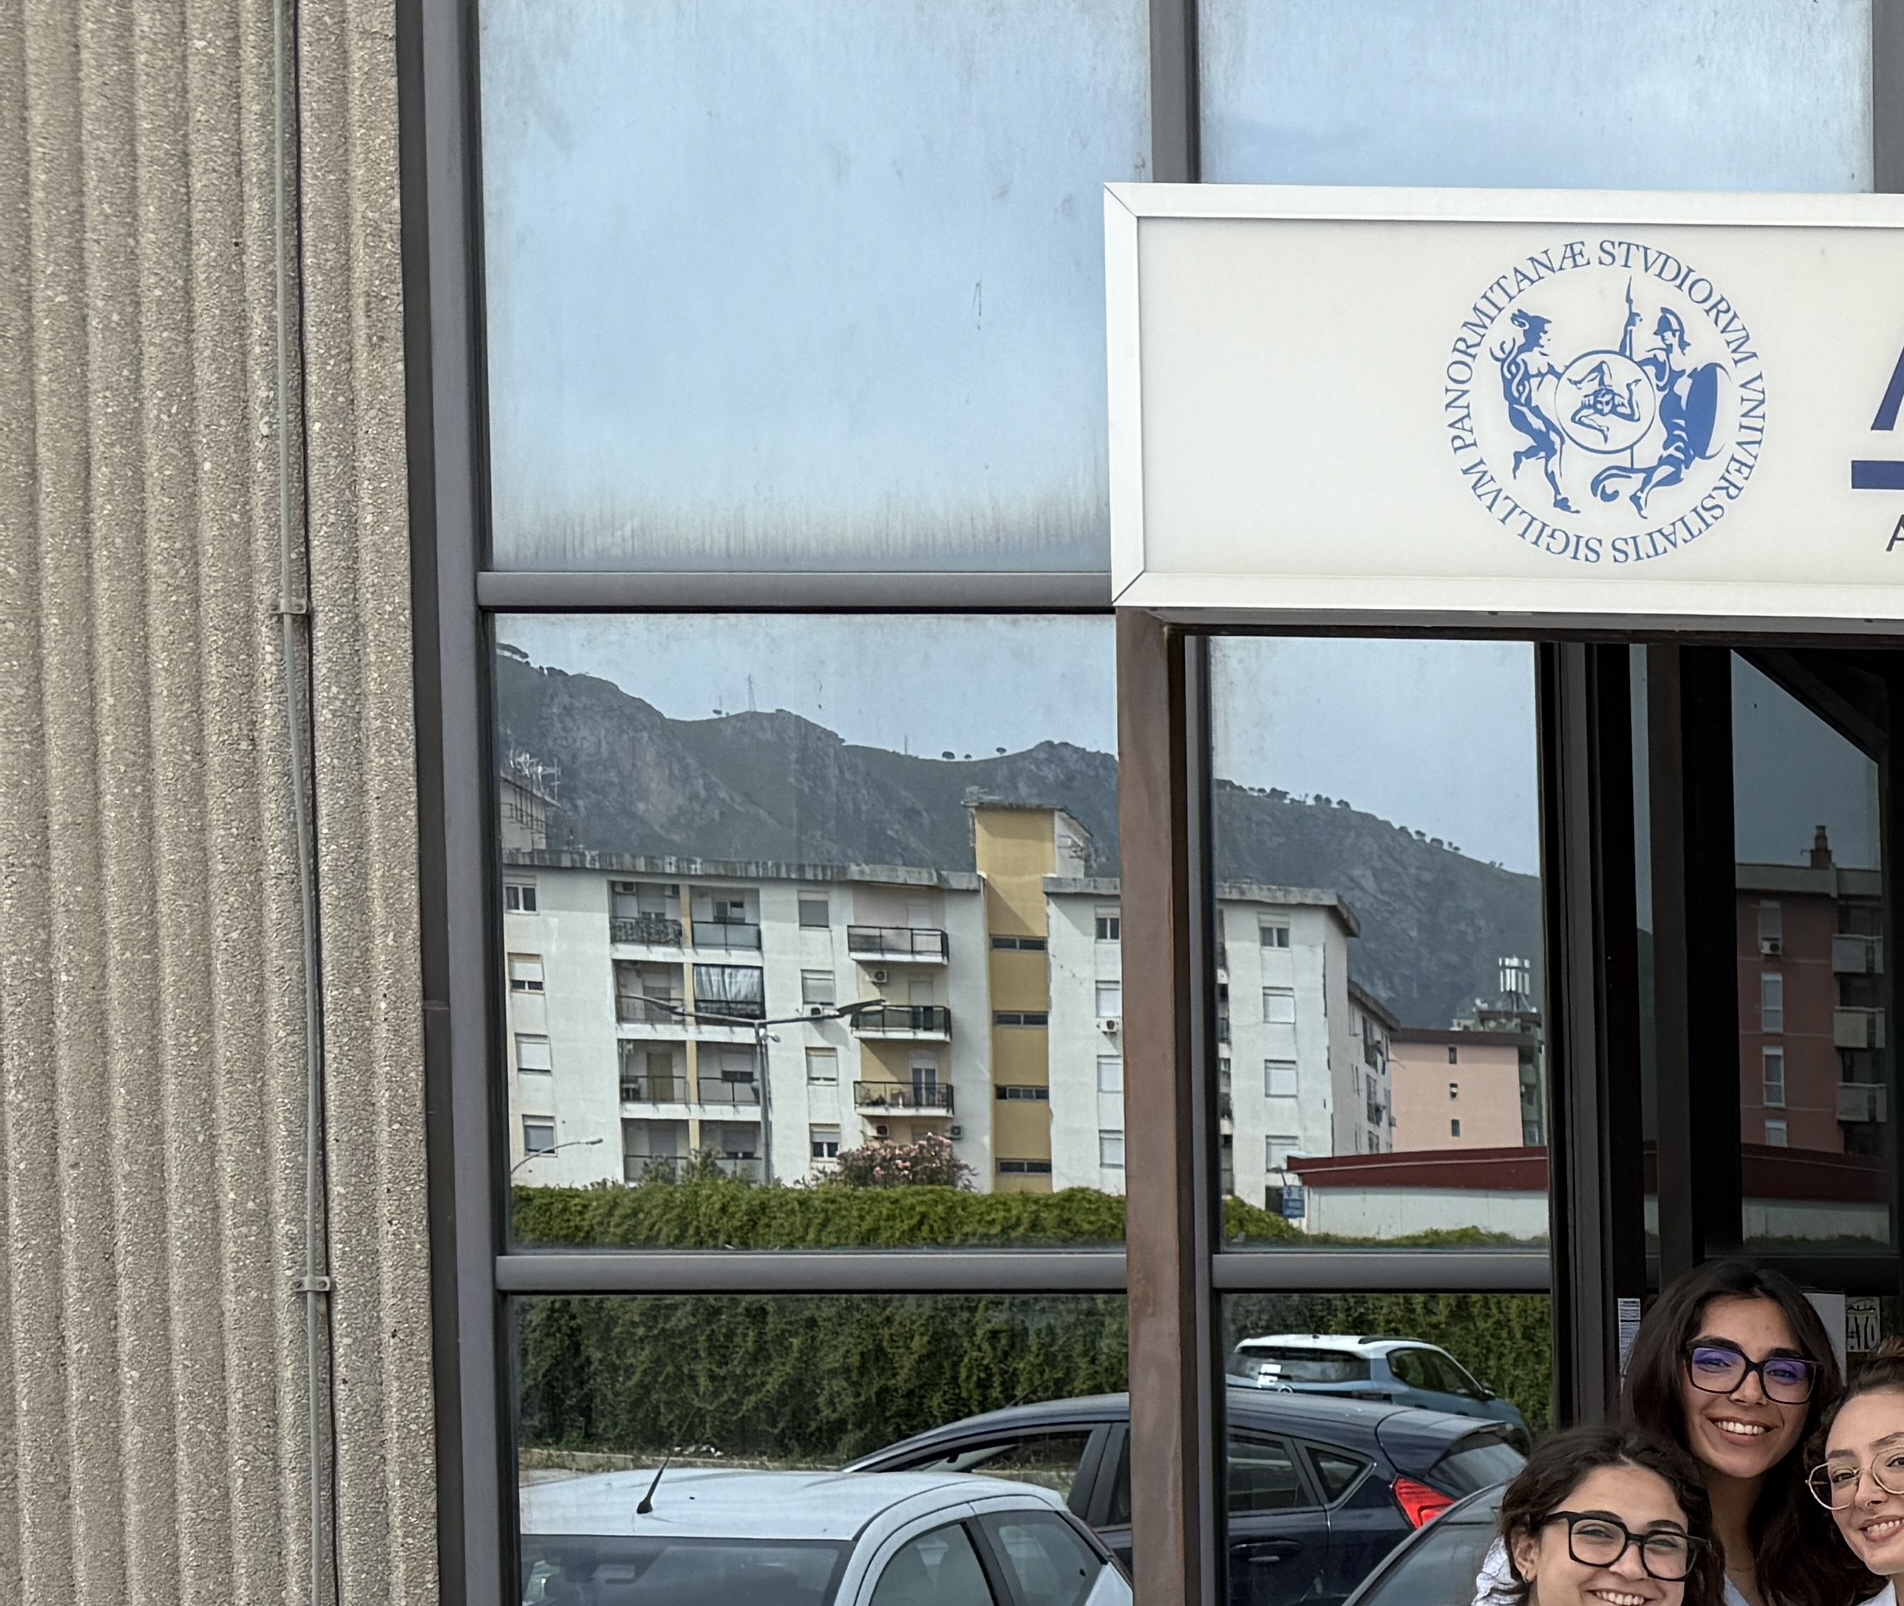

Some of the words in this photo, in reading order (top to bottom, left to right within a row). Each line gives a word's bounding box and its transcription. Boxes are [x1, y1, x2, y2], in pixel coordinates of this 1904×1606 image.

[1444, 241, 1590, 456] PANORMITANÆ
[1598, 240, 1759, 367] STVDIORVM
[1461, 459, 1603, 564] SIGILLVM
[1611, 371, 1767, 564] VNIVERSITATIS
